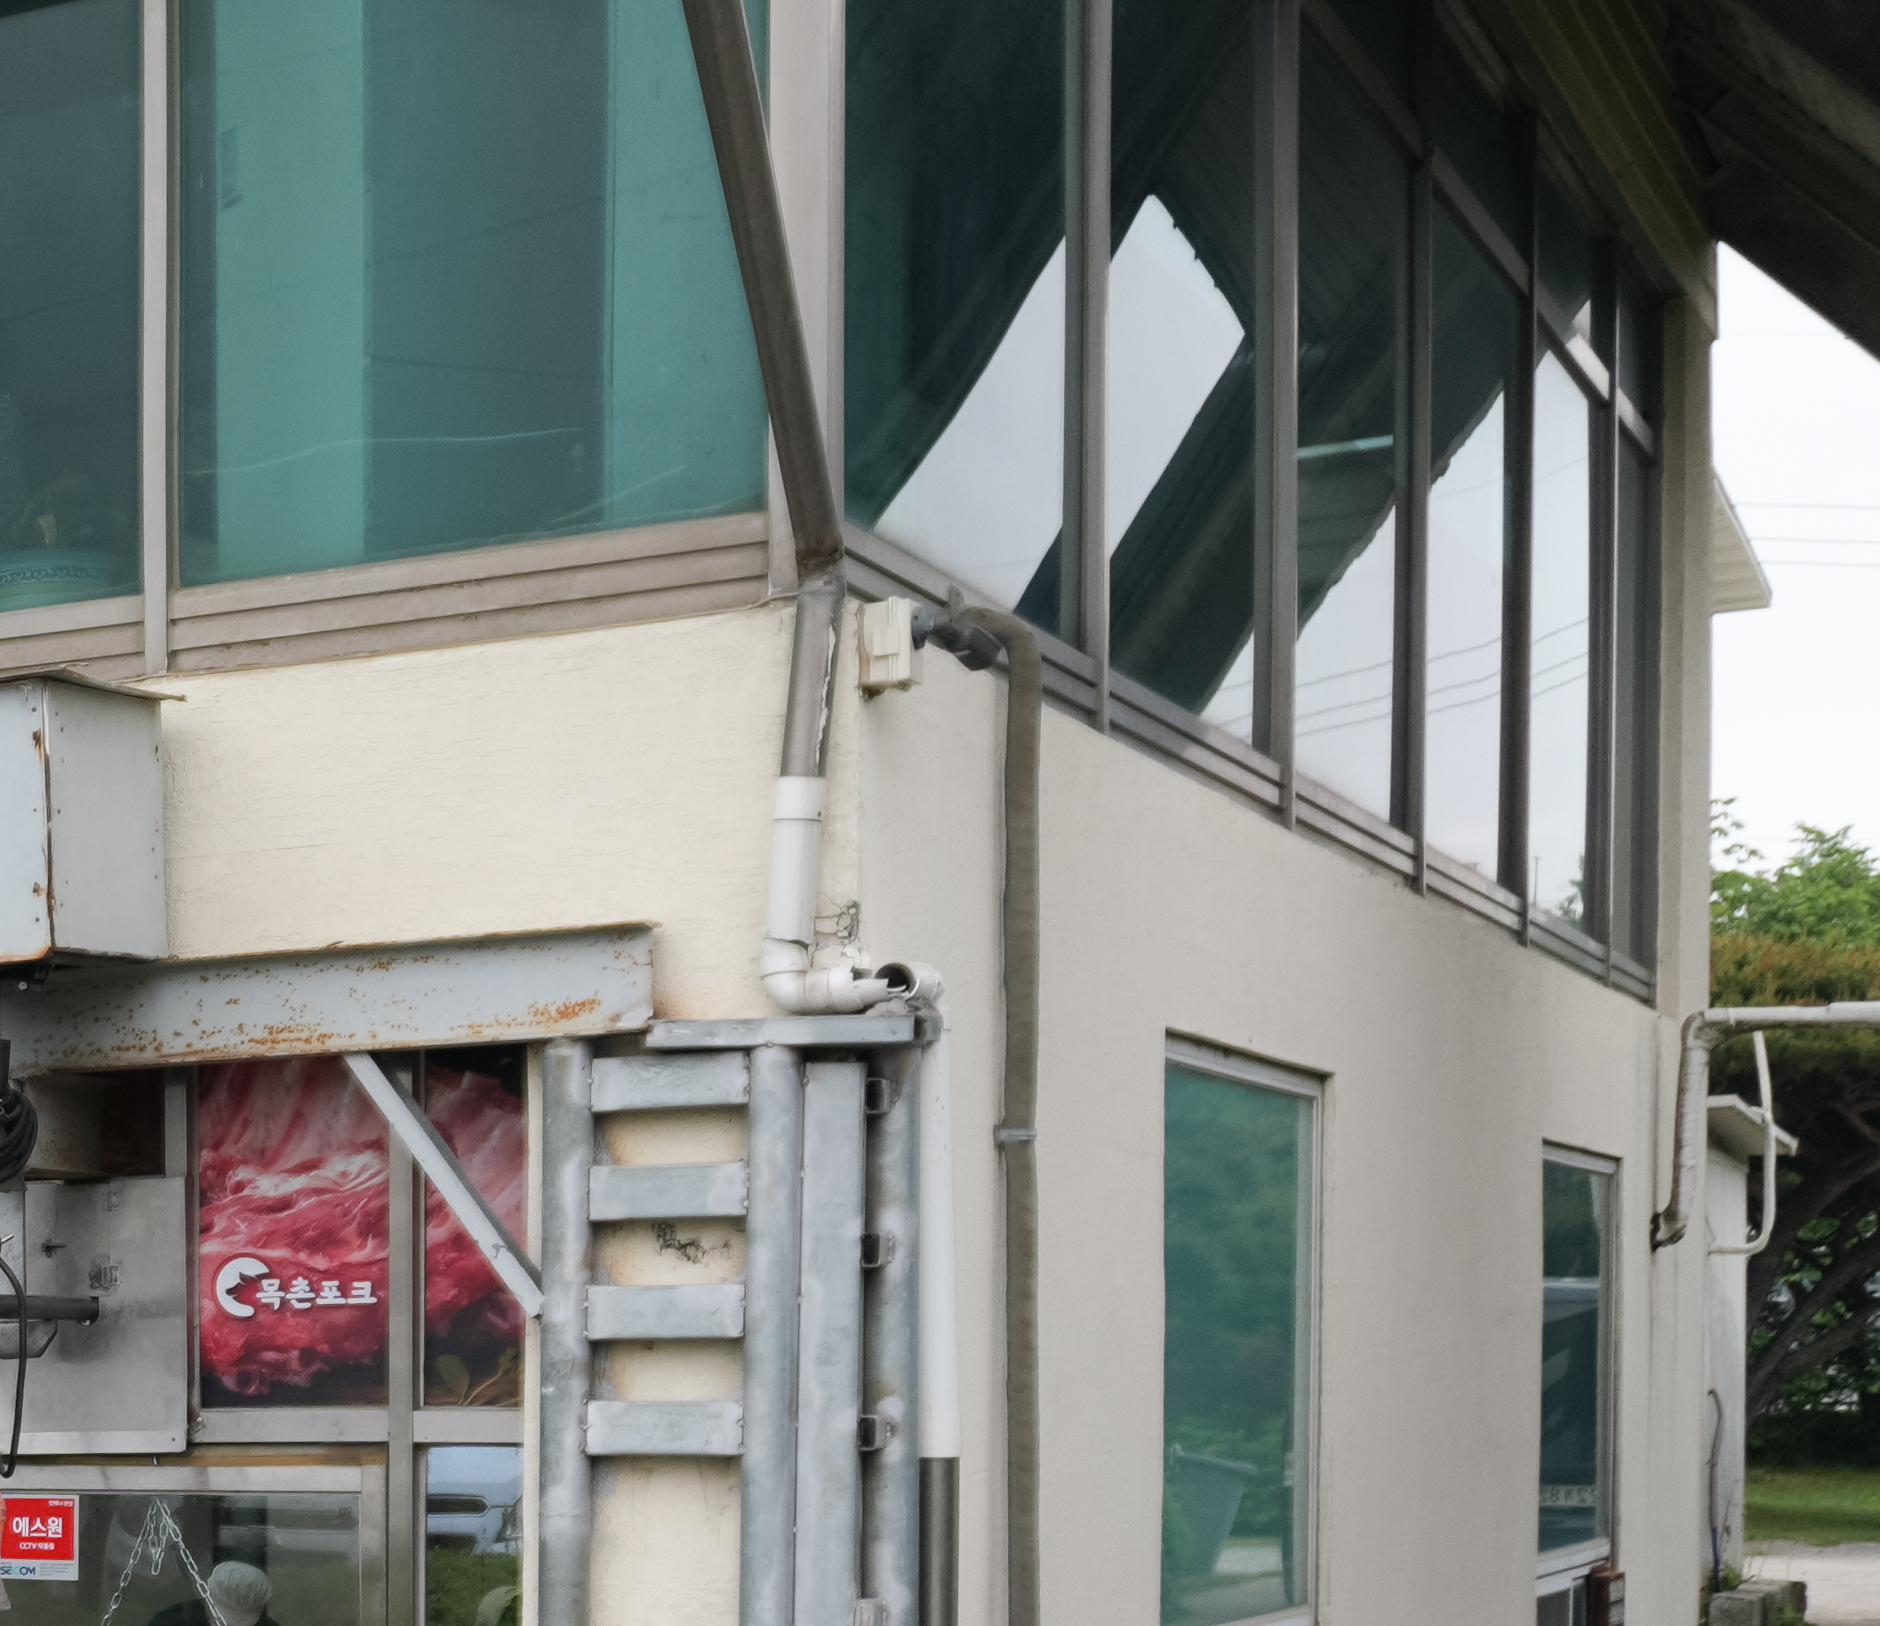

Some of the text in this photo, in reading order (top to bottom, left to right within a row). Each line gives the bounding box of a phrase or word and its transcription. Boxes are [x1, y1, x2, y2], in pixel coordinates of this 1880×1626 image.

[255, 1276, 378, 1311] 목촌포크
[12, 1516, 63, 1538] 에스원
[0, 1566, 35, 1576] SECOM
